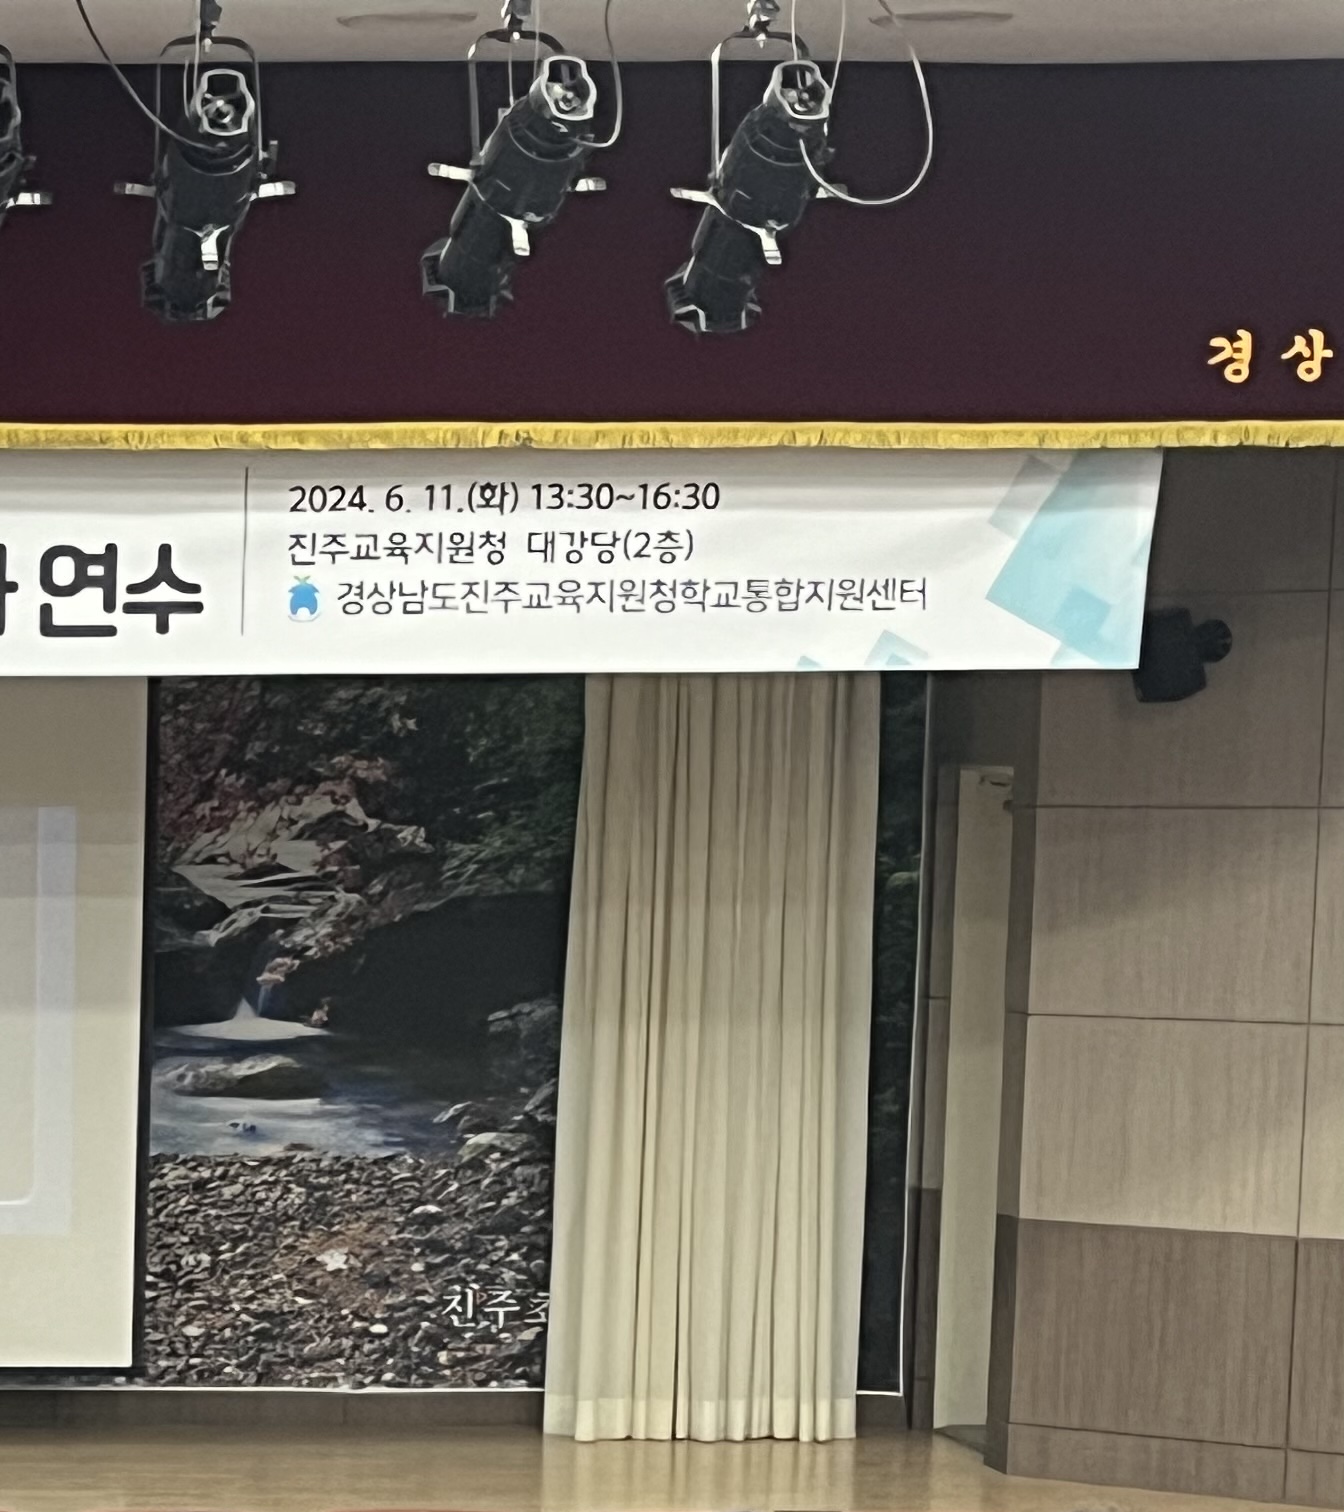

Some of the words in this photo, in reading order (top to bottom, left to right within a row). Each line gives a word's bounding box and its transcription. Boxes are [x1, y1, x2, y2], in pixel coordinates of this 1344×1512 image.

[288, 484, 375, 513] 2024.
[384, 484, 412, 513] 6.
[423, 481, 519, 516] 11.(화)
[529, 482, 721, 512] 13:30~16:30
[287, 530, 507, 566] 진주교육지원청
[527, 528, 694, 565] 대강당(2층)
[39, 542, 205, 638] 연수
[337, 577, 926, 616] 경상남도진주교육지원청학교통합지원센터
